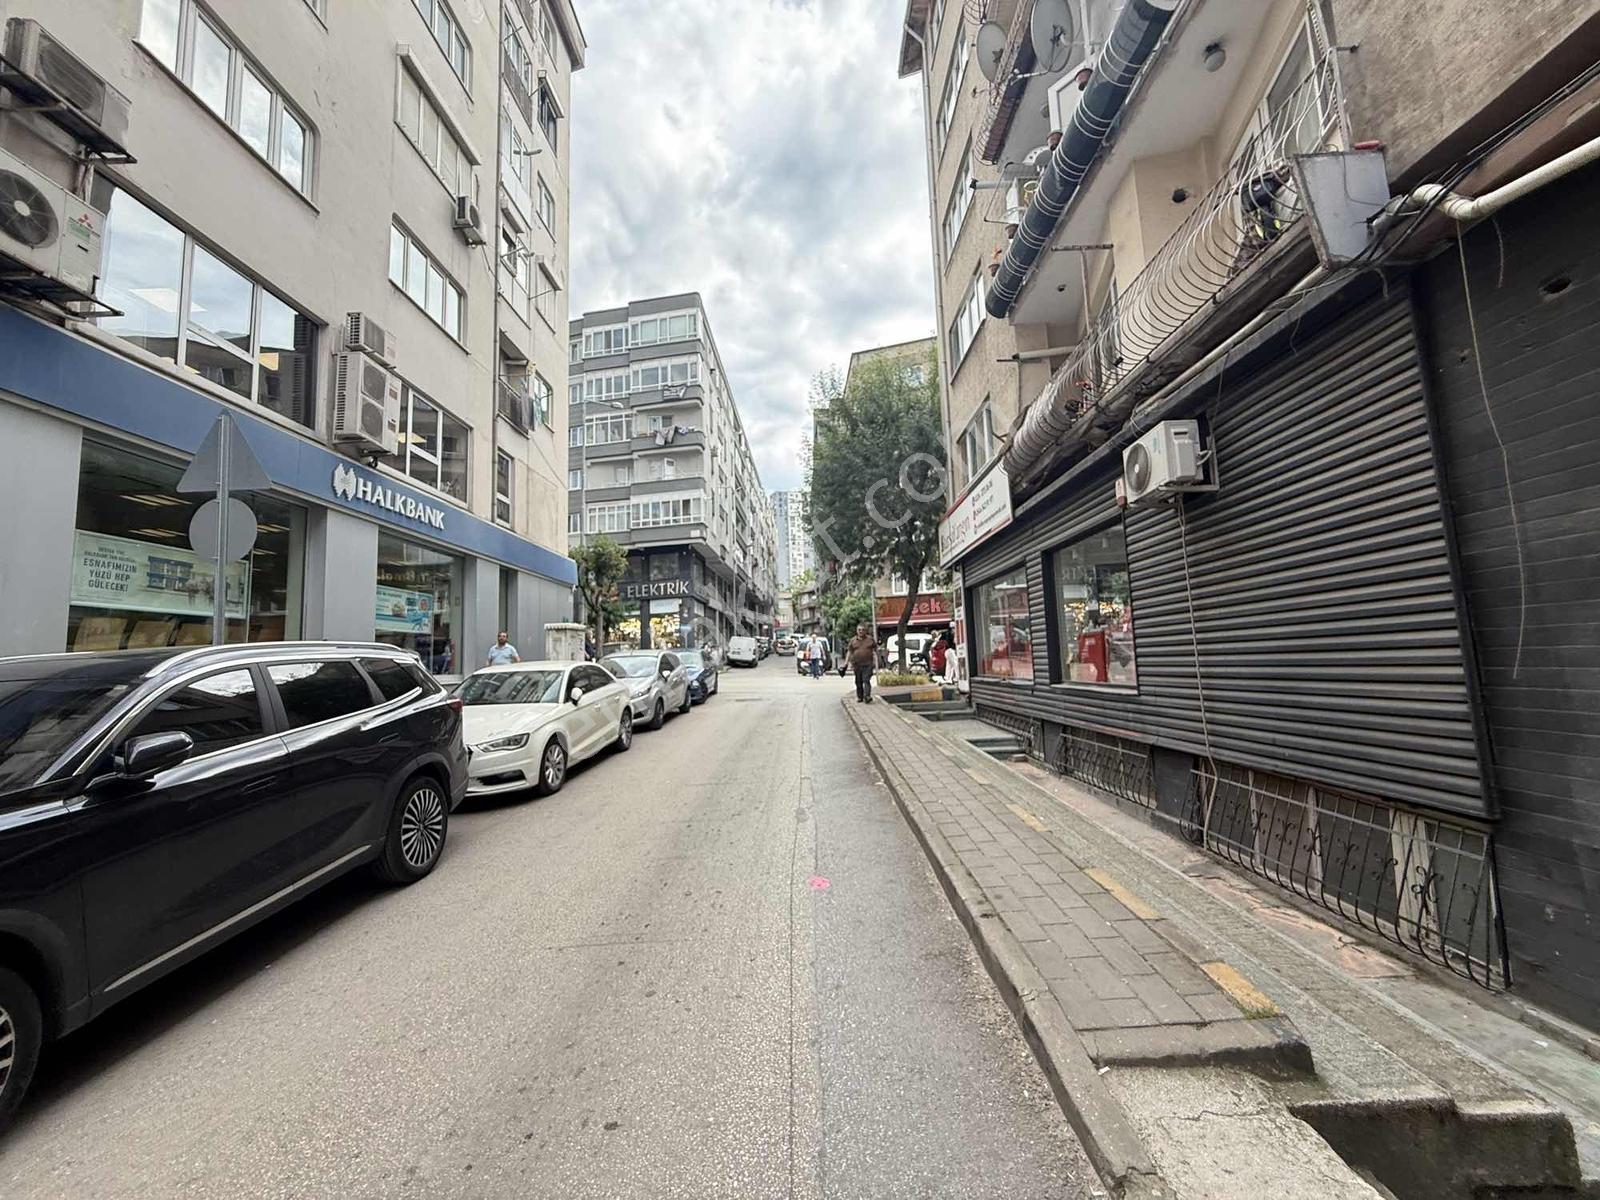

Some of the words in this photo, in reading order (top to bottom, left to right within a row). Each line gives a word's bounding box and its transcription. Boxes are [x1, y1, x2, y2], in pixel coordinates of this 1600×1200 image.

[357, 478, 445, 530] HALKBANK
[115, 573, 131, 582] HEP
[627, 579, 689, 598] ELEKTRİK
